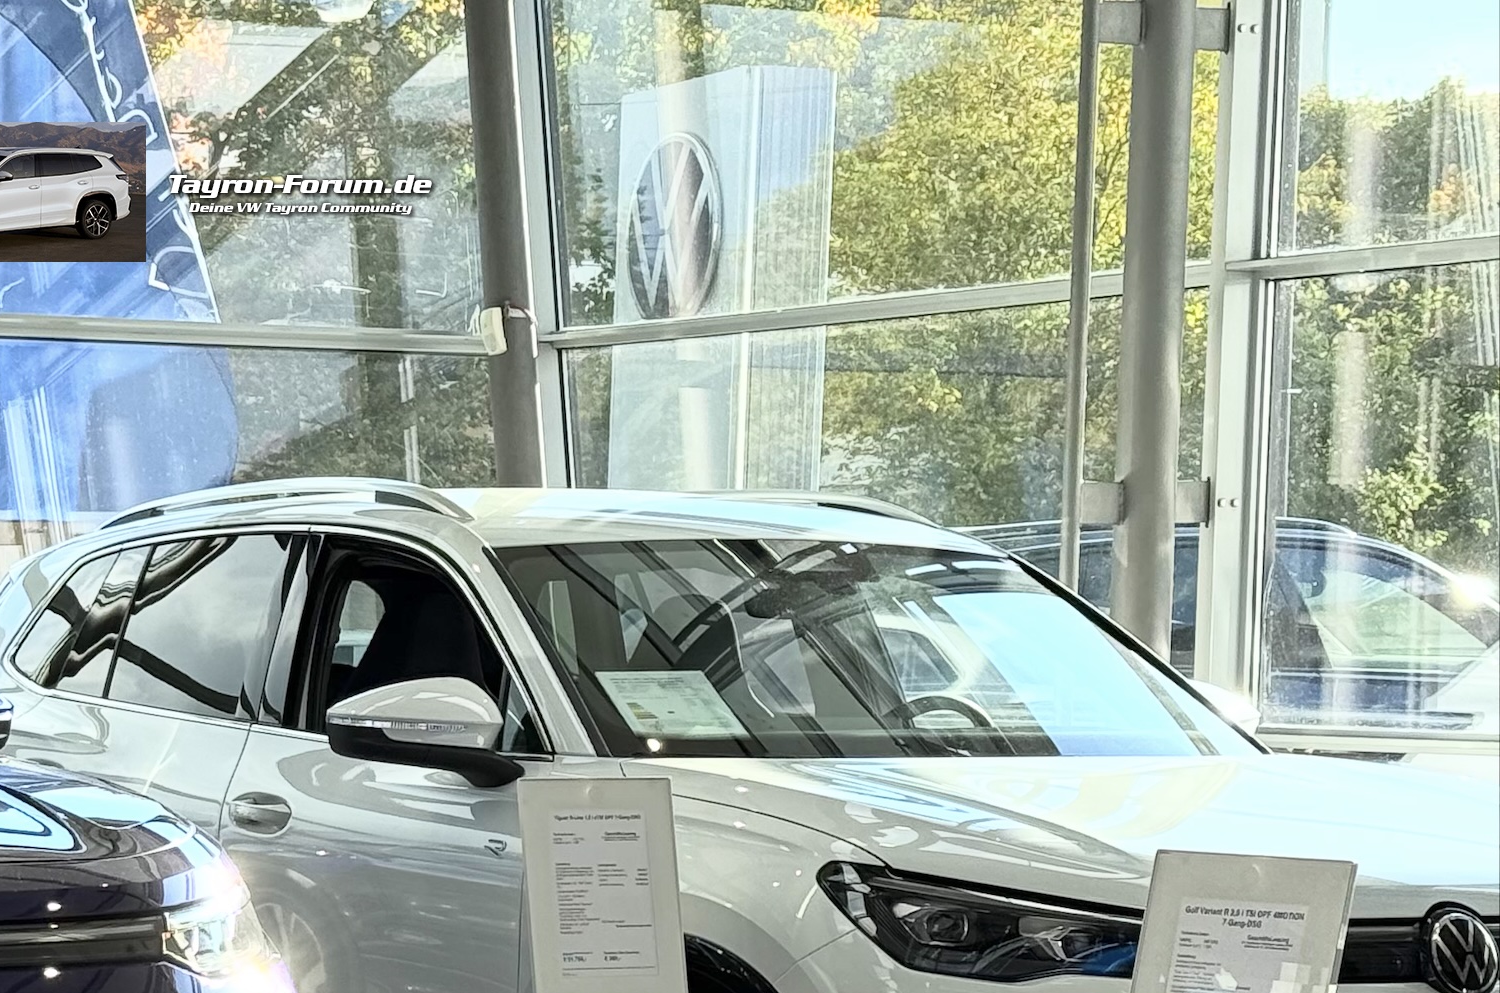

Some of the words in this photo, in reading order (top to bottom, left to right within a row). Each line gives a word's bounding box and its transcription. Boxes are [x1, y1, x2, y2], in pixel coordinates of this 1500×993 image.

[1185, 905, 1199, 914] Golf
[1200, 907, 1222, 916] Variant
[1223, 908, 1229, 916] R
